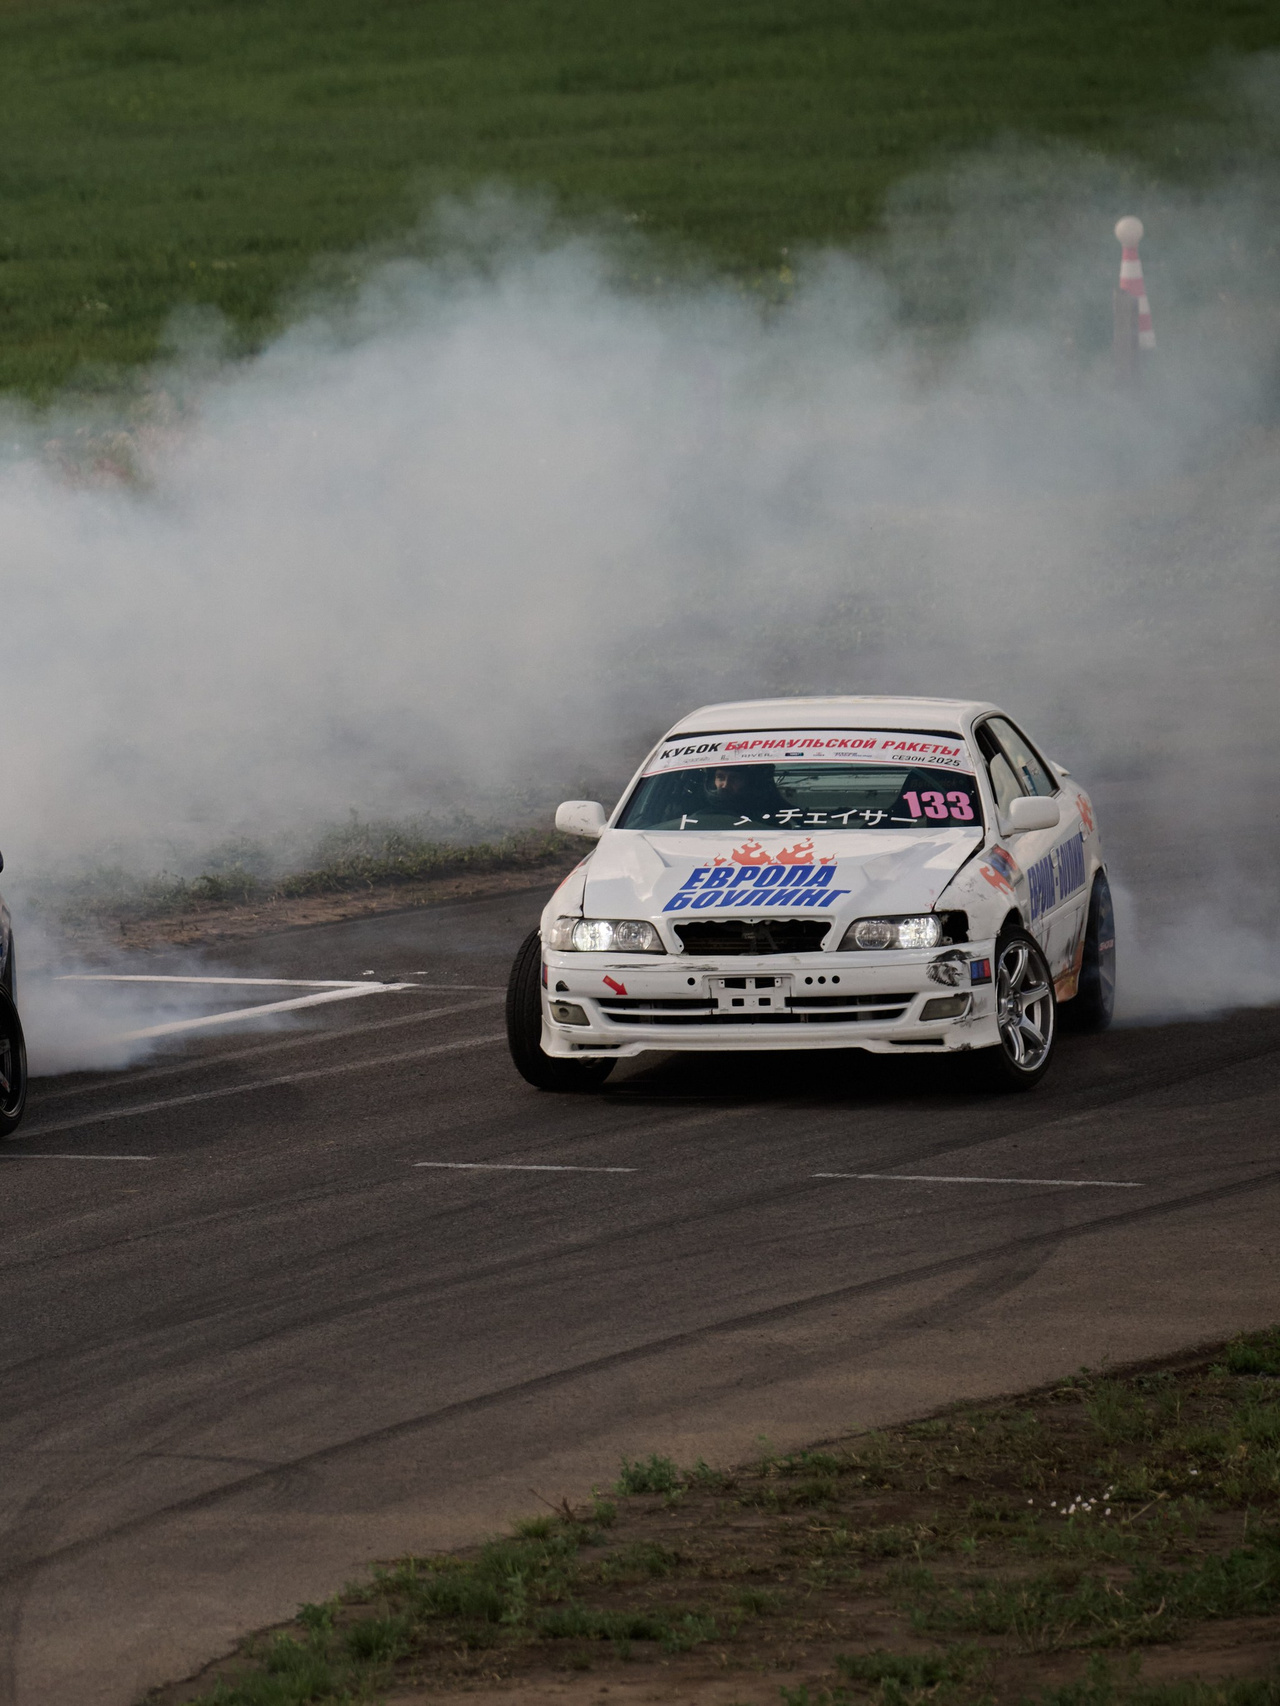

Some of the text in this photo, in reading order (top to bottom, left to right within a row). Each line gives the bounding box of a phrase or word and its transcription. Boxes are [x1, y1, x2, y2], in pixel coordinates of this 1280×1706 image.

[660, 742, 722, 760] КУБОК
[725, 738, 877, 751] БАРНАУЛЬСКОЙ
[881, 741, 961, 756] РАКЕТЫ
[892, 754, 961, 767] СЕЗОН 2025
[902, 791, 974, 820] 133
[679, 865, 838, 890] ЕВРОПА
[662, 889, 852, 913] БОУЛИНГ
